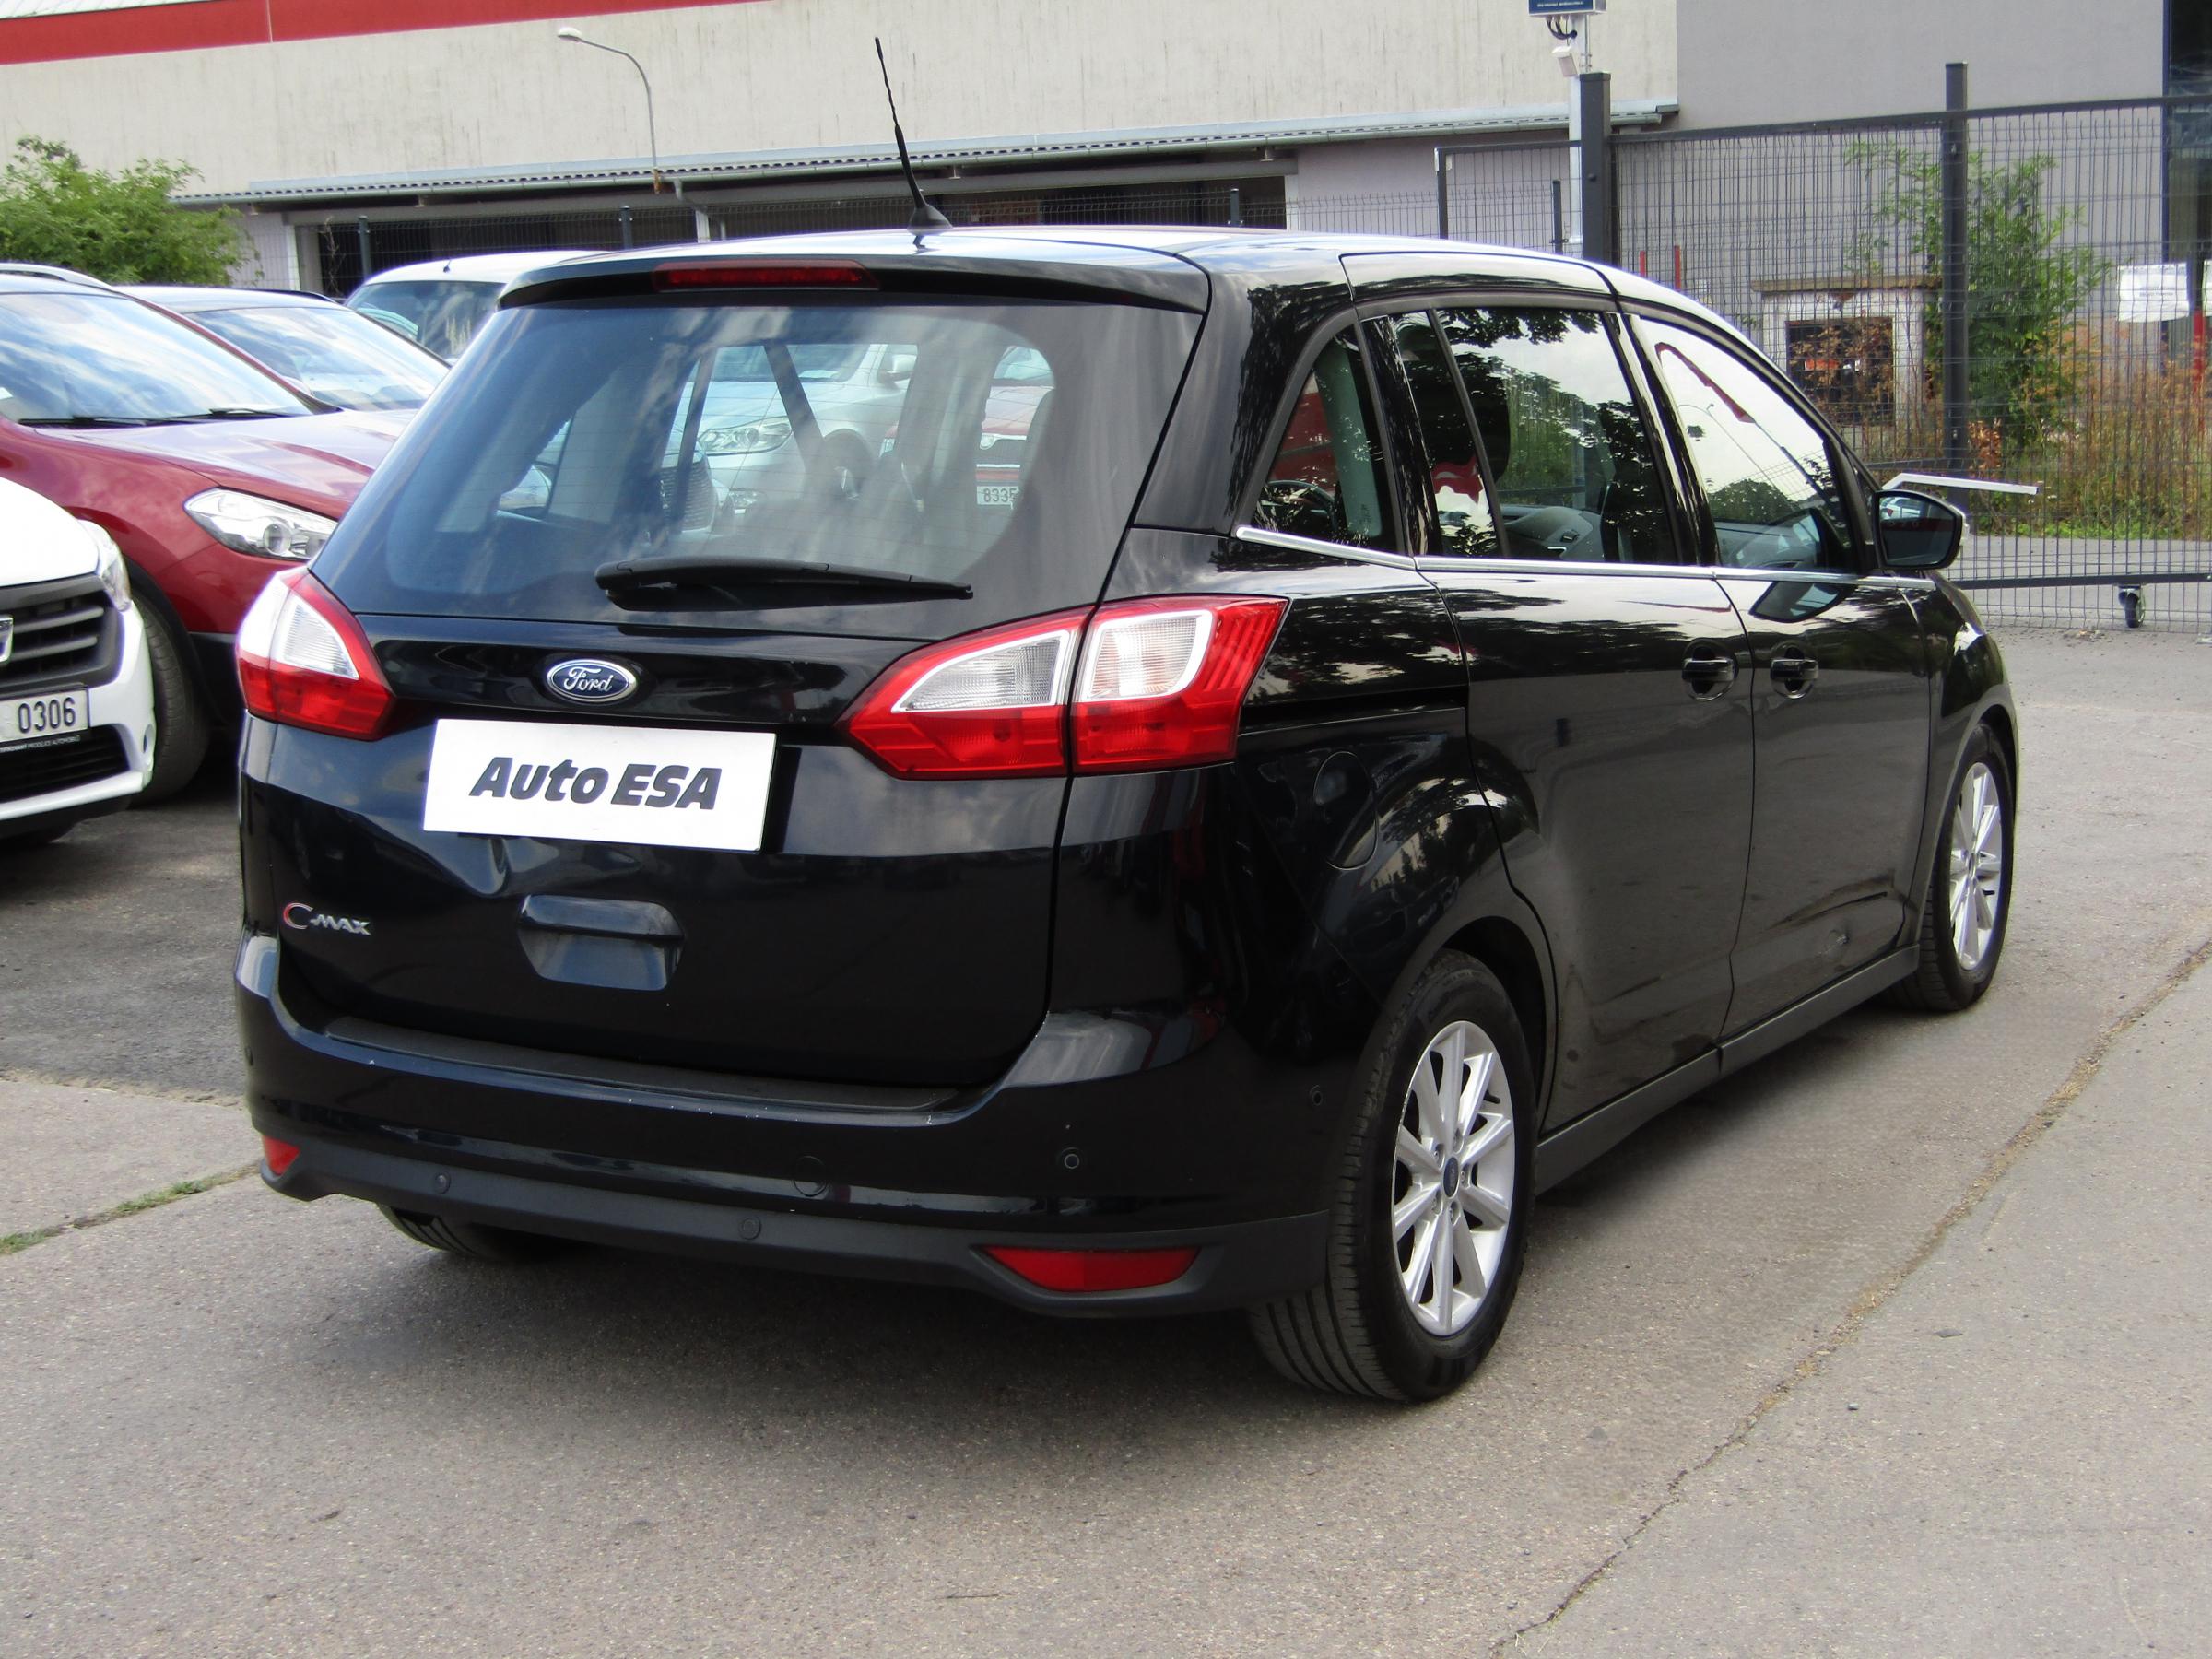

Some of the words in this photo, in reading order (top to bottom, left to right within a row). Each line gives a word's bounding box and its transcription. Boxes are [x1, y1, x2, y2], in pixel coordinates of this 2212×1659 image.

[563, 666, 614, 692] Ford
[18, 697, 76, 734] 0306
[468, 756, 609, 804] Auto
[610, 763, 723, 810] ESA
[283, 902, 371, 935] C-MAX
